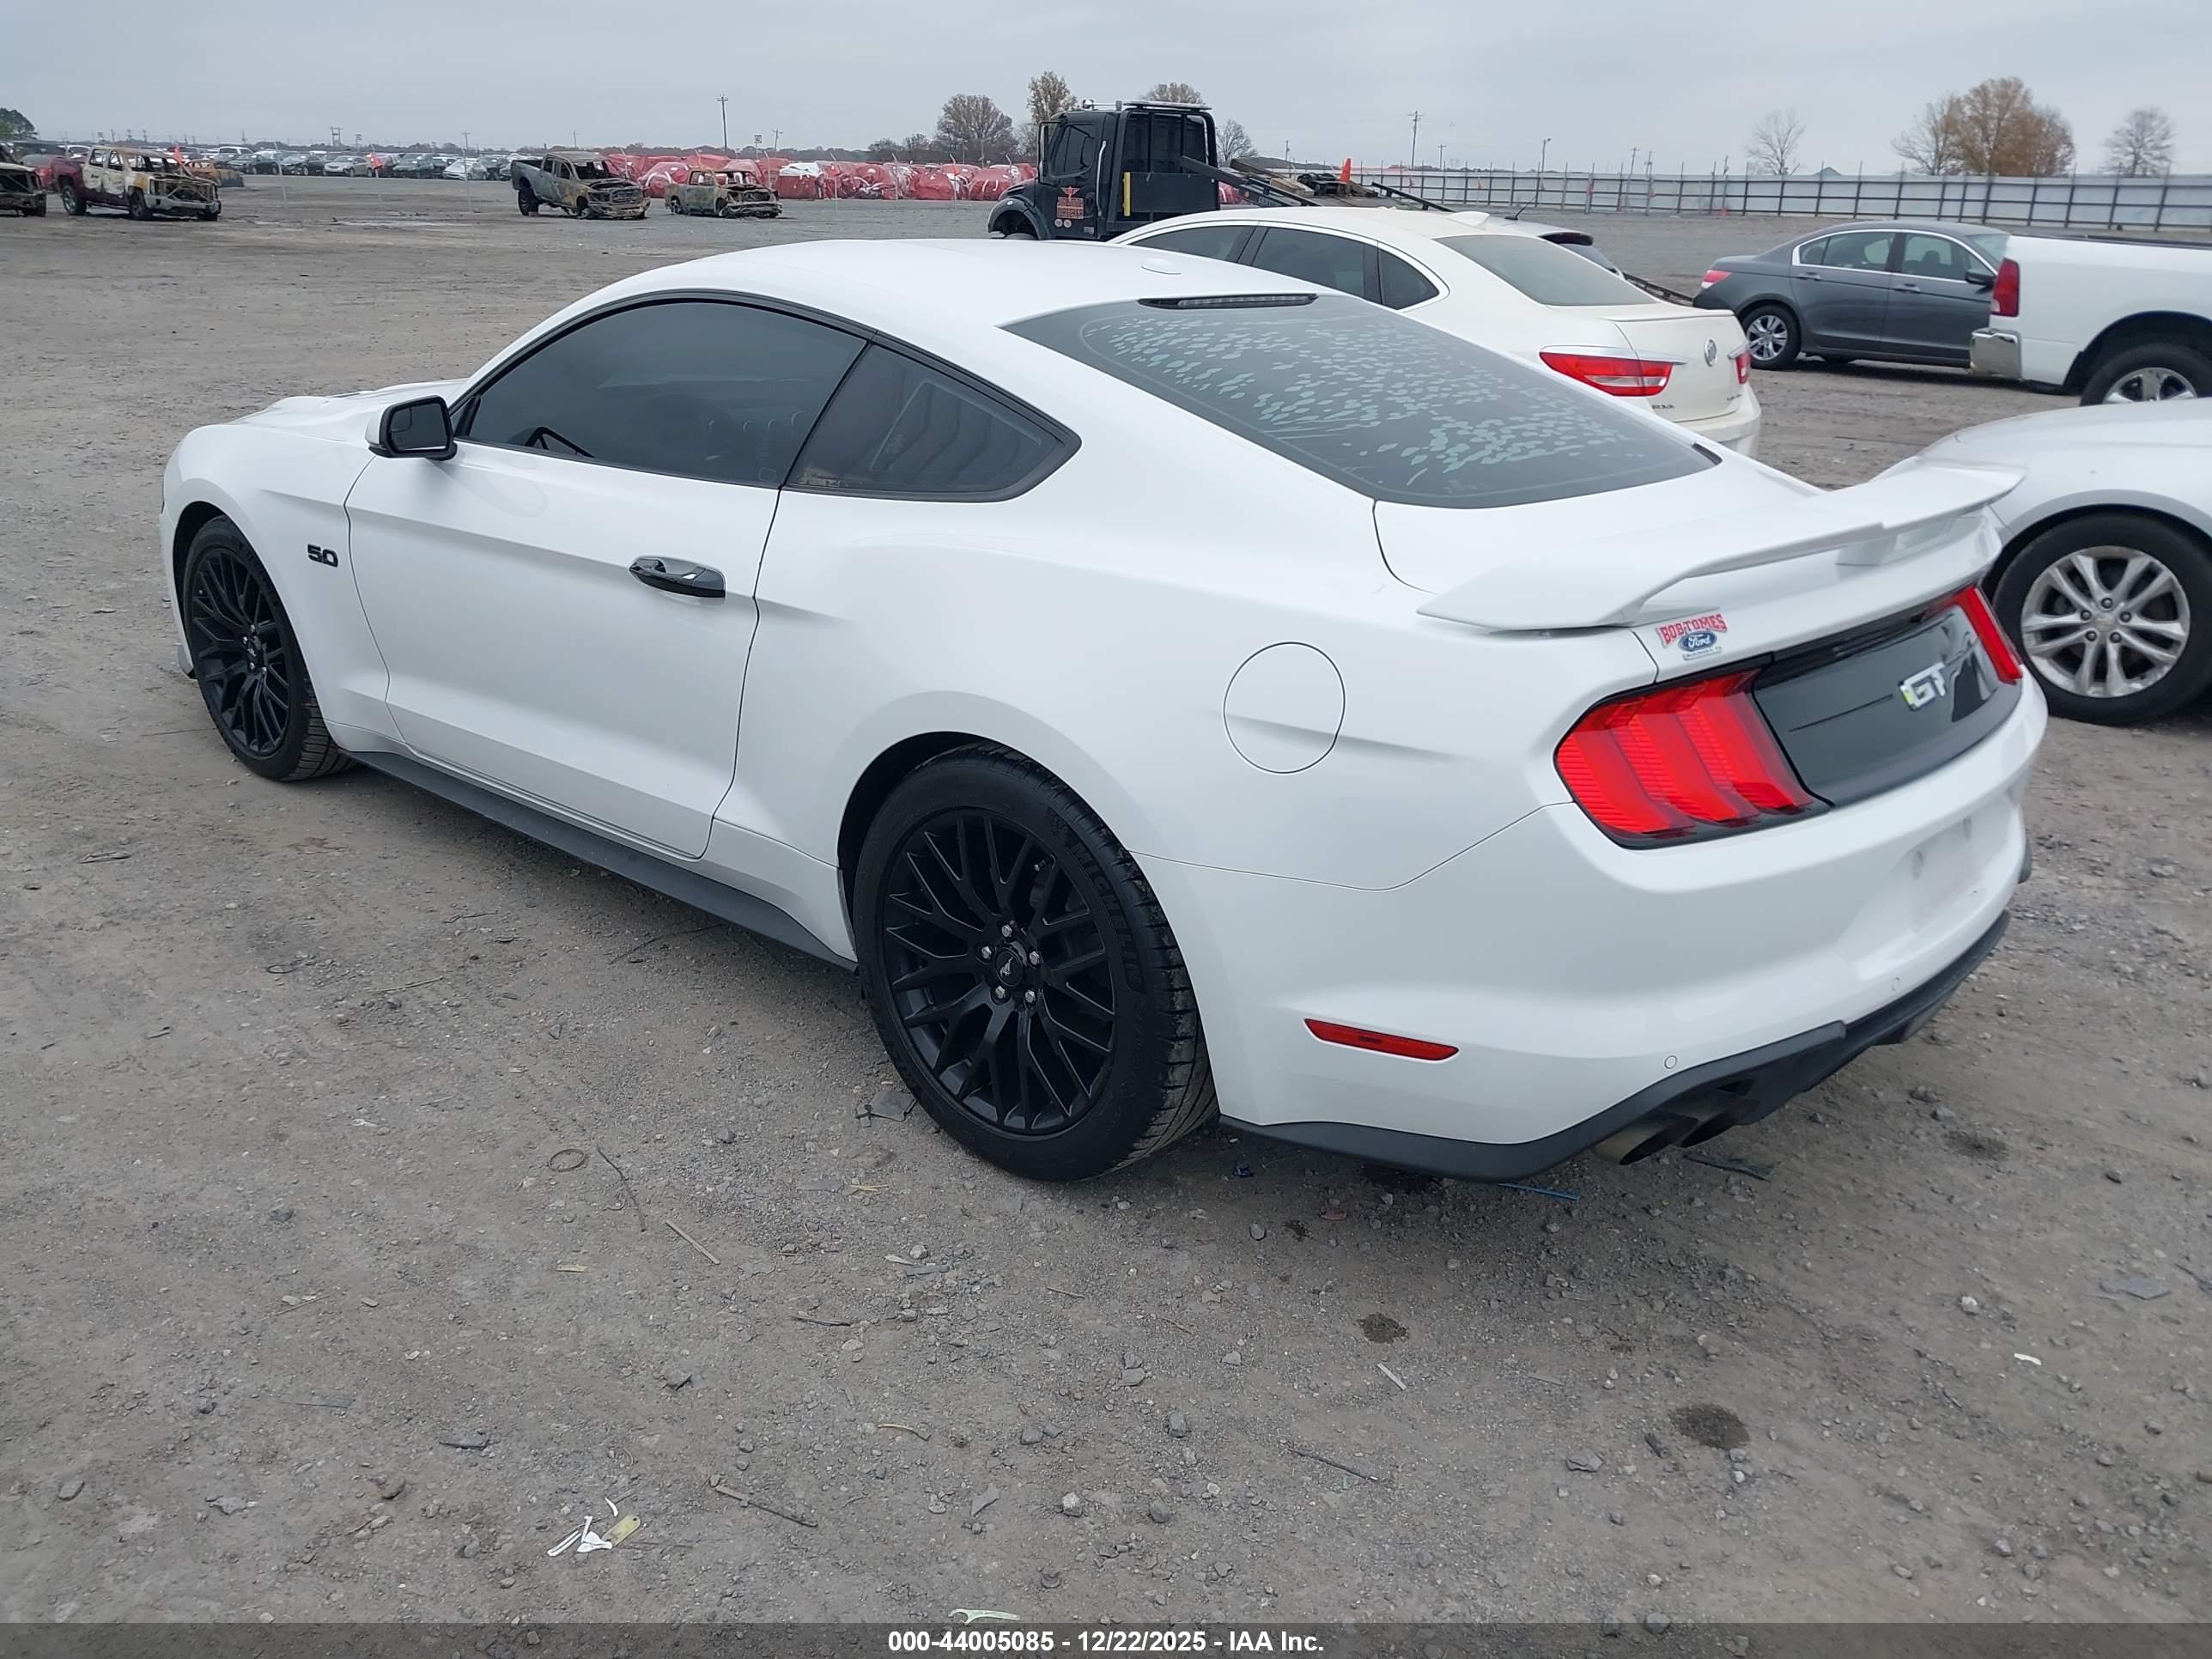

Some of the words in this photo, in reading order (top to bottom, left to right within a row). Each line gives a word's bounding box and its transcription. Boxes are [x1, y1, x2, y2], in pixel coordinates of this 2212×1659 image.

[1660, 623, 1684, 645] BOB
[1683, 613, 1728, 632] TOMES
[1687, 634, 1711, 648] Ford
[1899, 661, 1947, 710] GT
